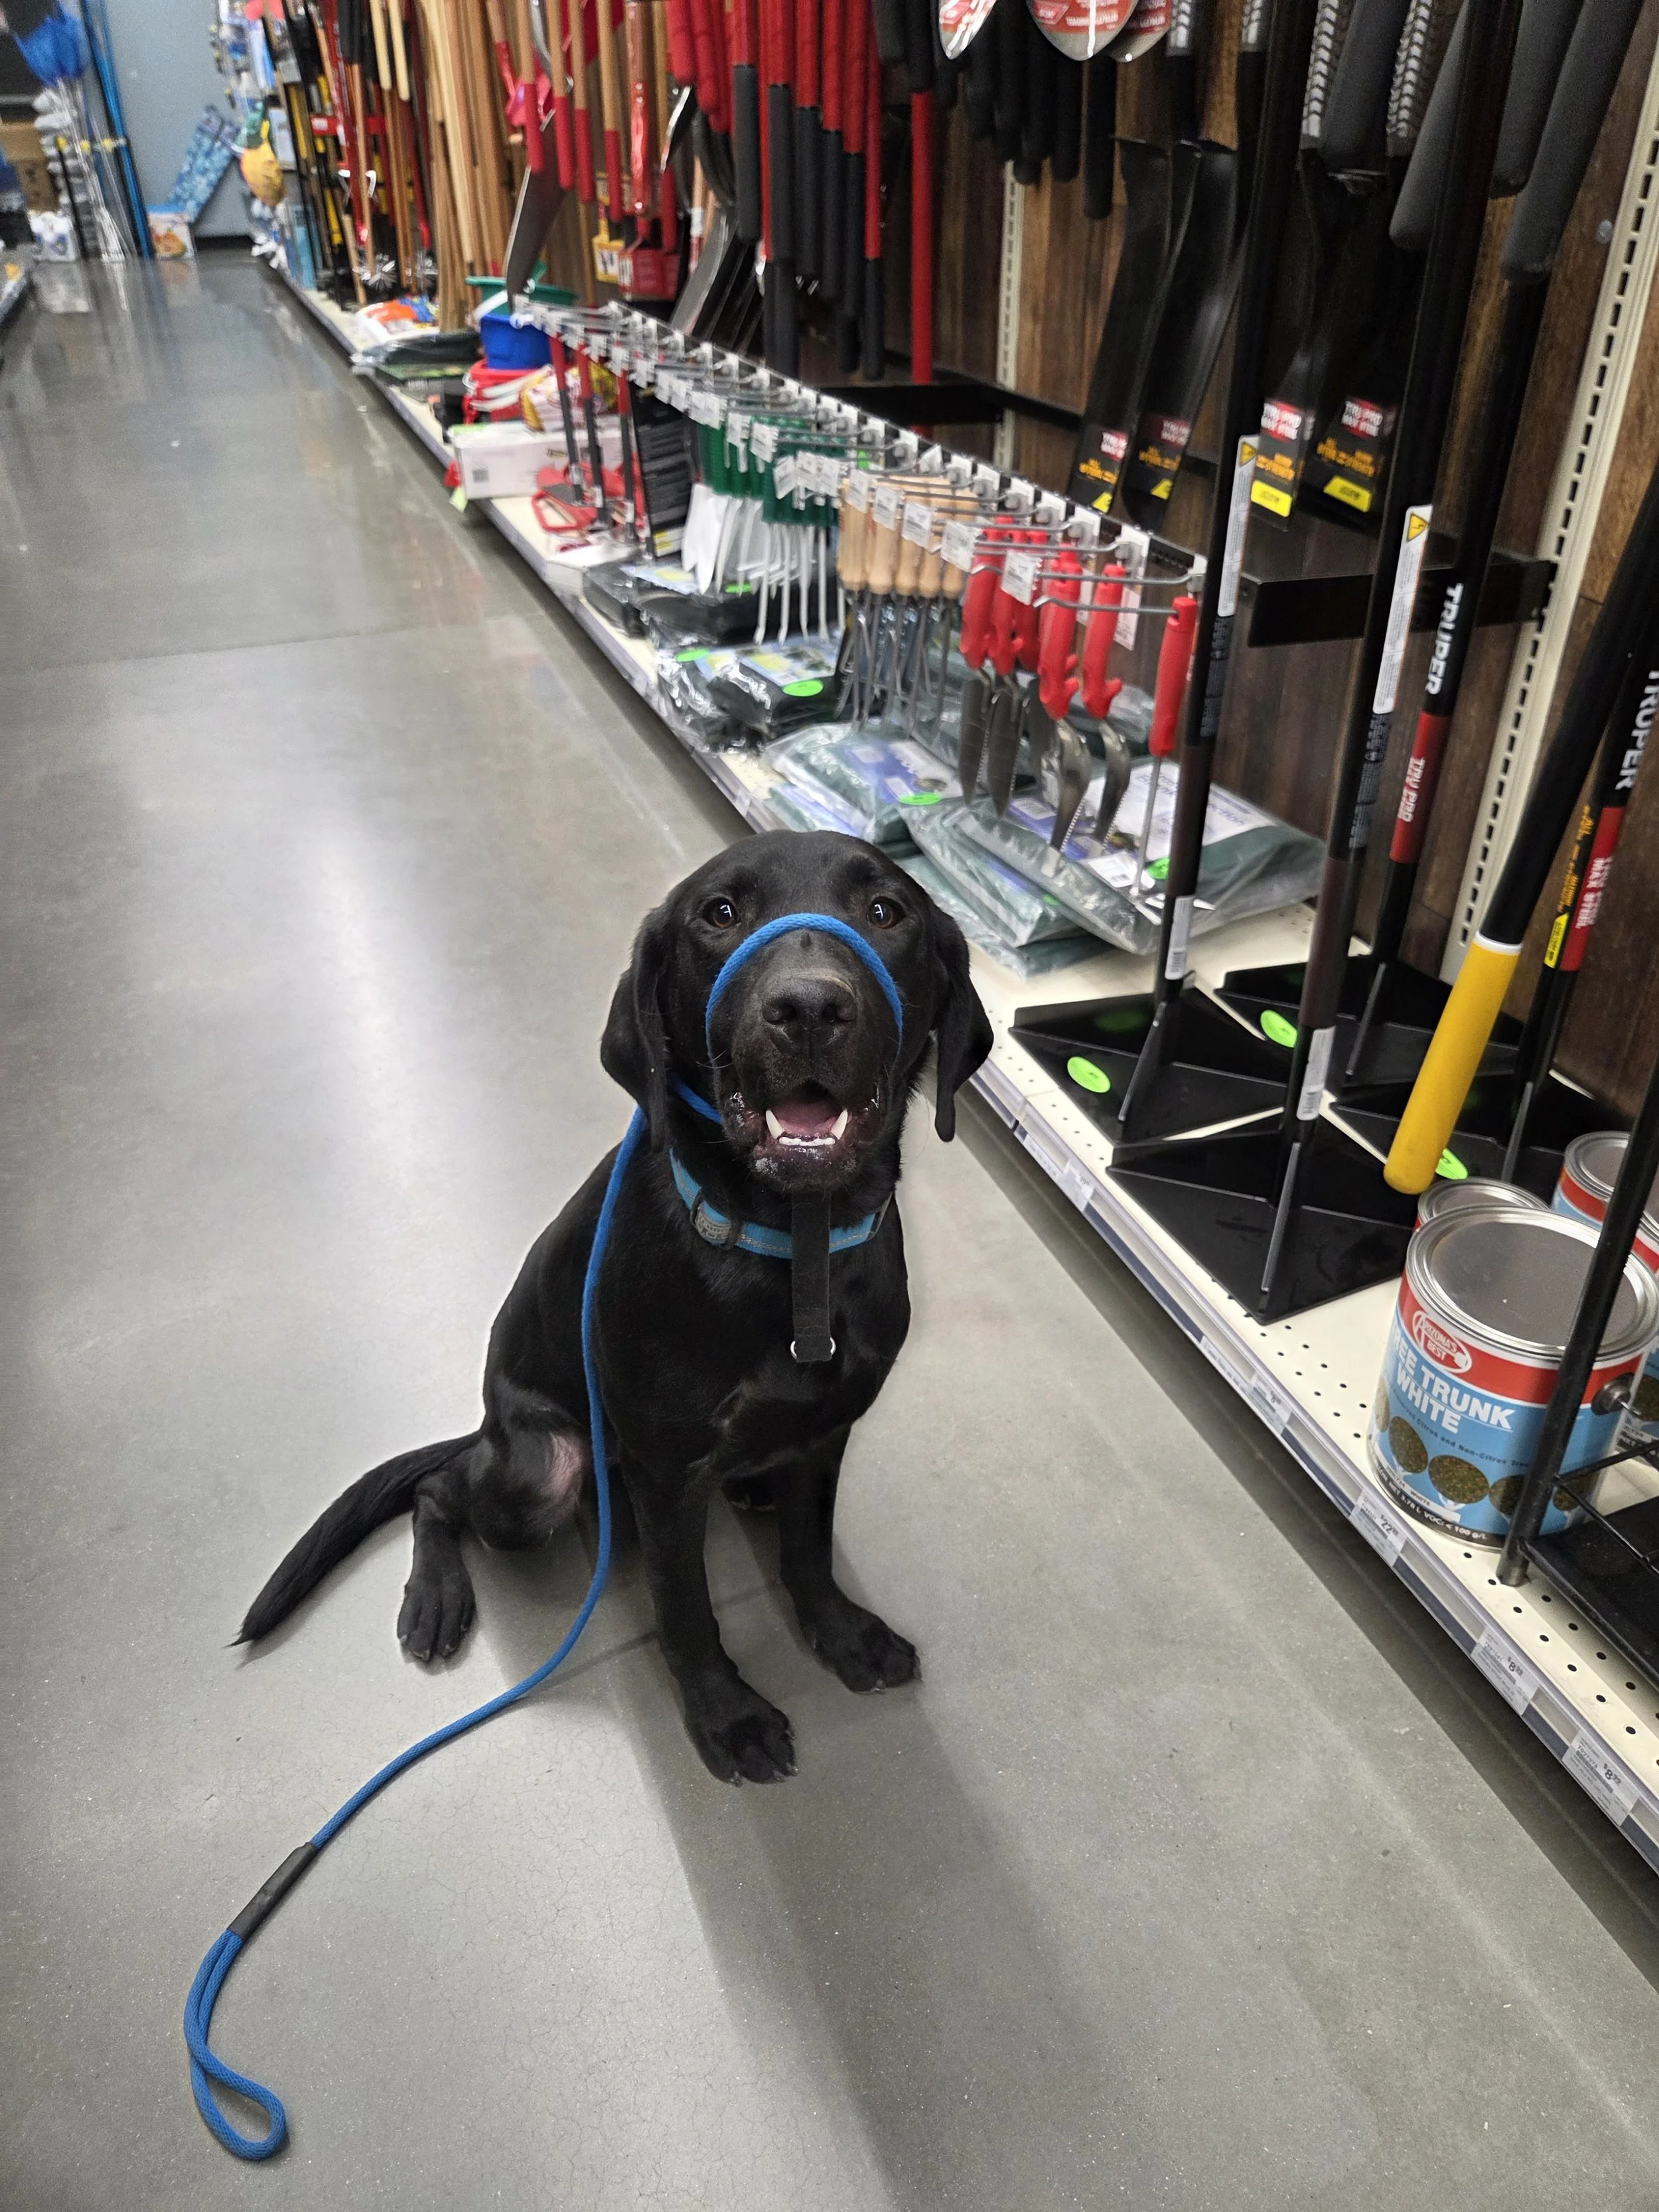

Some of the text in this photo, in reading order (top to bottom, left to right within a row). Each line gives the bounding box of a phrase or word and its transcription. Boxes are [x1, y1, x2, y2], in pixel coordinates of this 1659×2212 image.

[1425, 582, 1464, 695] TRUPER
[1427, 1339, 1447, 1361] BEST
[1397, 1362, 1461, 1434] WHITE
[1421, 1364, 1516, 1429] TRUNK
[1441, 1436, 1456, 1447] and
[1455, 1526, 1471, 1536] 100
